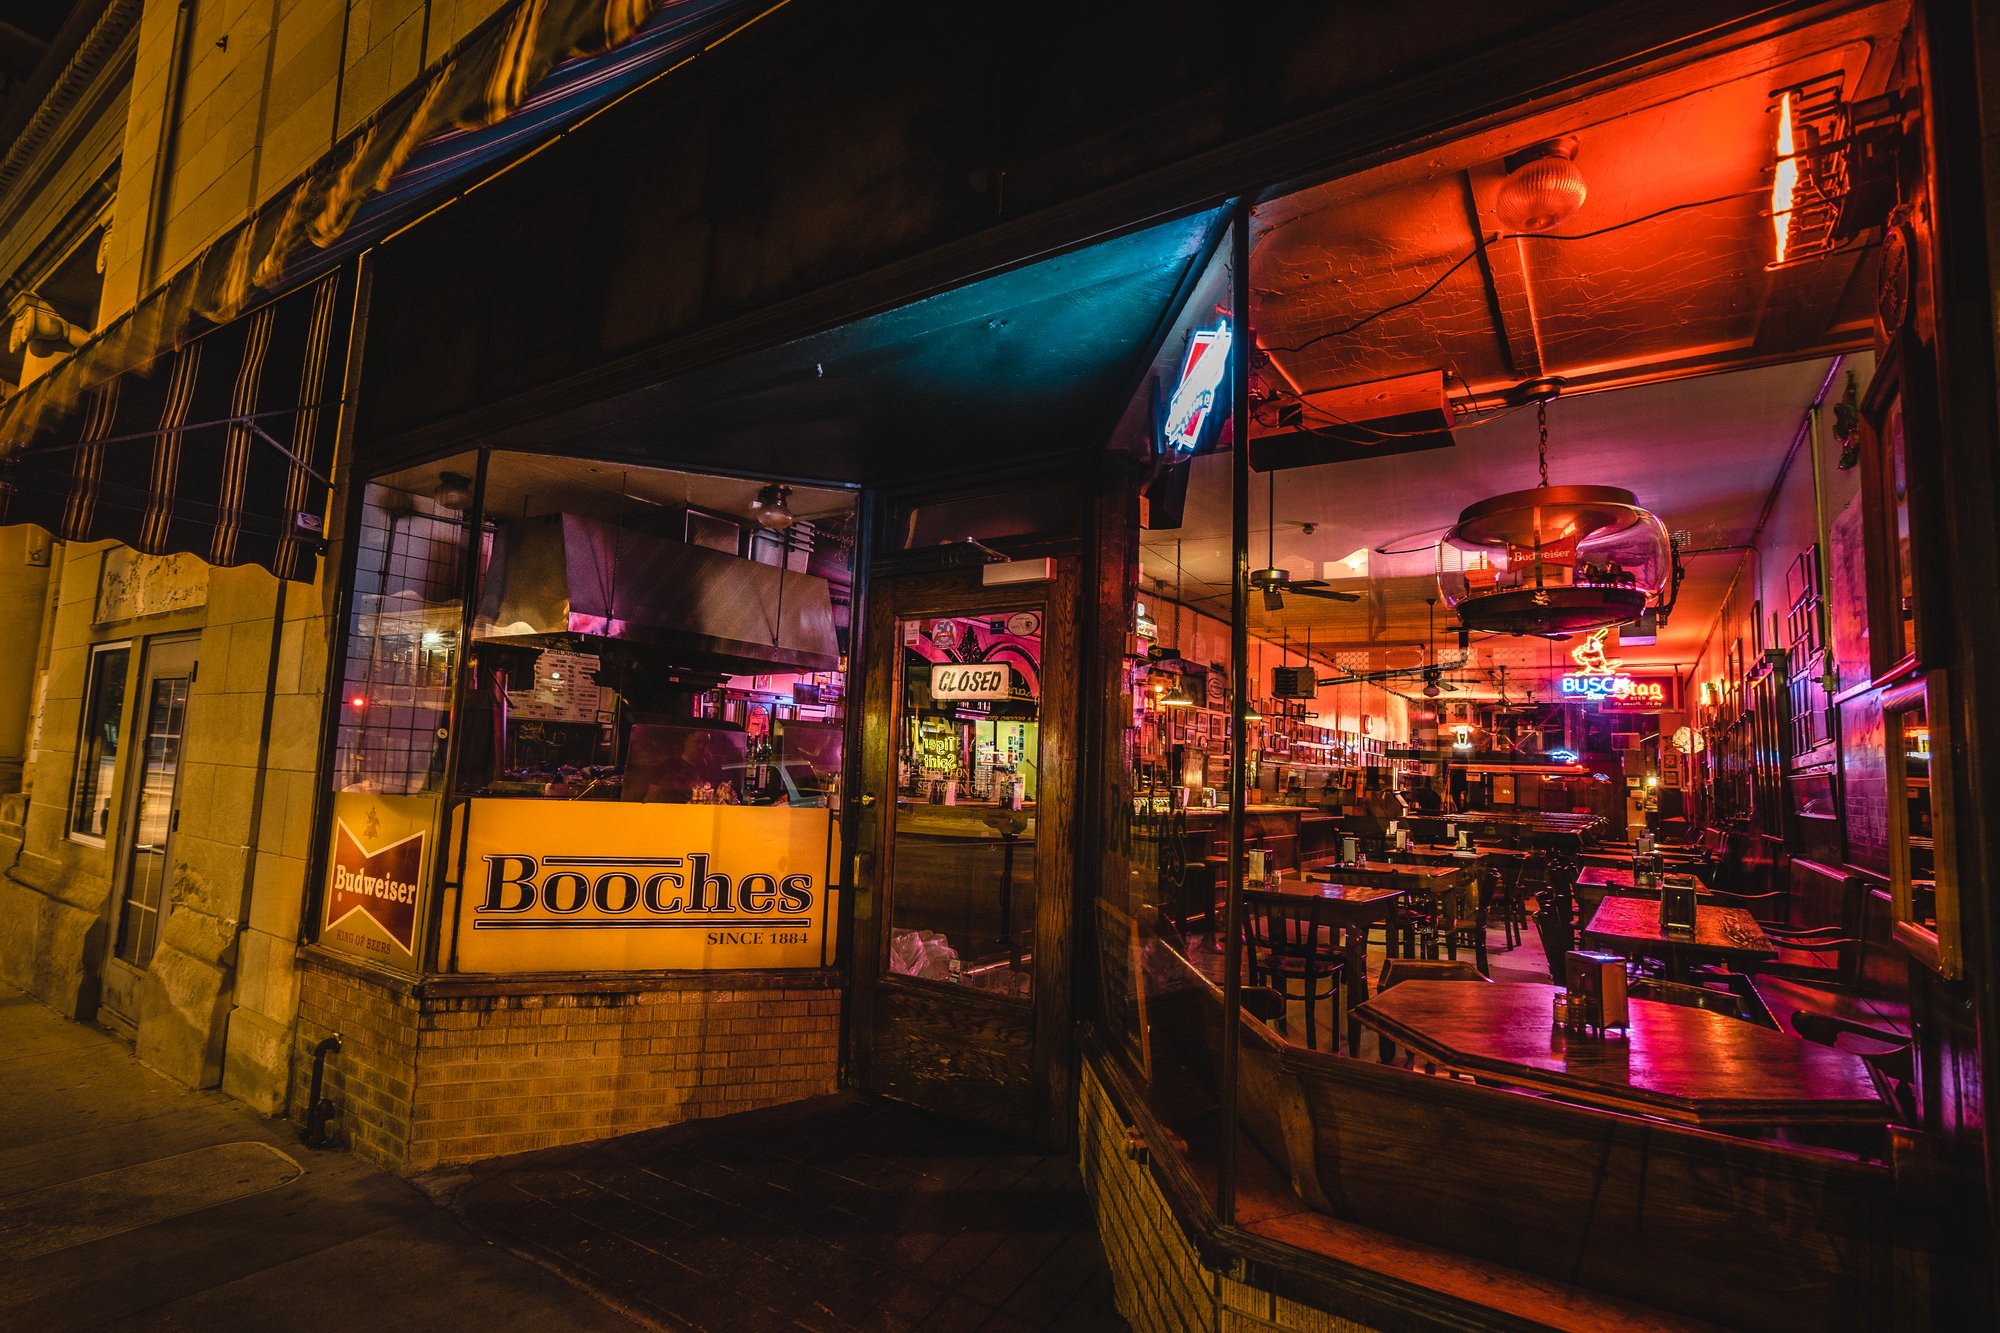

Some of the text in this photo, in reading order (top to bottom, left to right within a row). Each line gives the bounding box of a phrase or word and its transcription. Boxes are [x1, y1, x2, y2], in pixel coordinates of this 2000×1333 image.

[938, 670, 1002, 692] CLOSED
[335, 864, 415, 904] Budweiser
[474, 853, 813, 914] Booches
[336, 929, 391, 955] KING OF BEERS
[707, 931, 808, 945] SINCE 1884
